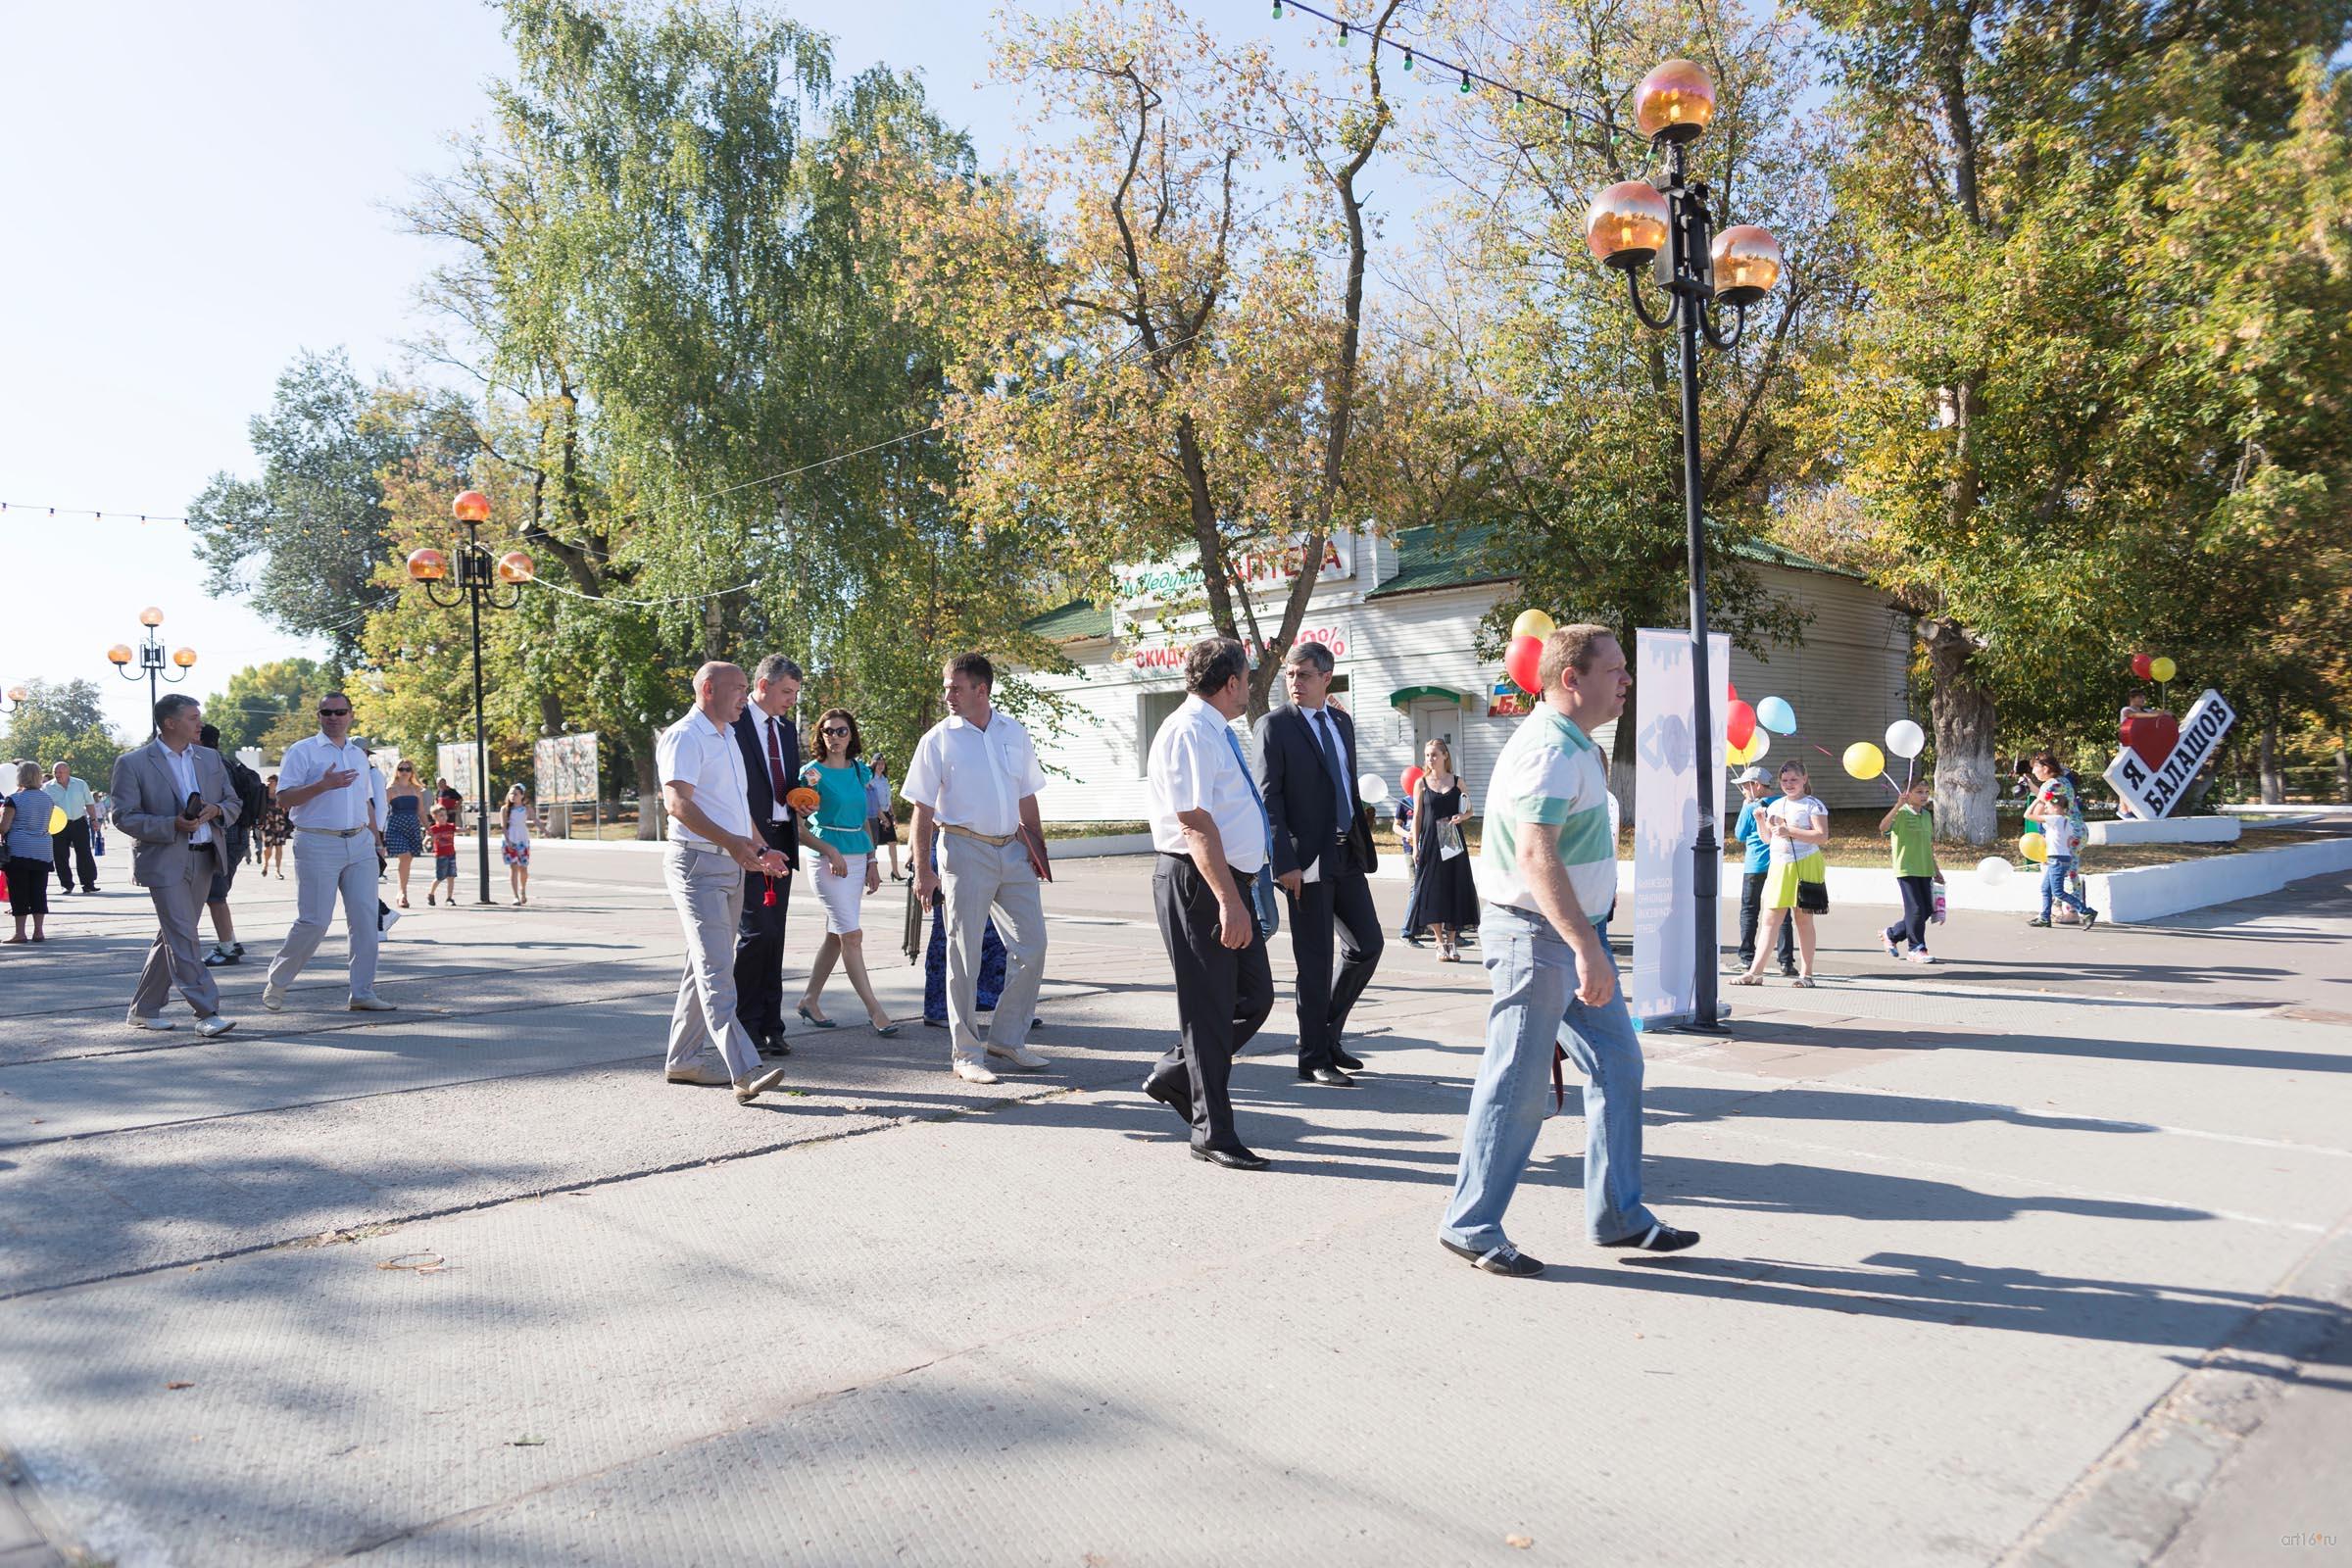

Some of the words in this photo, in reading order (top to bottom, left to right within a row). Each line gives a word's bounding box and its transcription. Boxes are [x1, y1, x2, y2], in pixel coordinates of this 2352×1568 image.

[1227, 540, 1342, 582] ПТЕА
[1136, 646, 1188, 669] СКИДК
[2123, 759, 2147, 791] Я
[2143, 700, 2228, 817] БАЛАШОВ
